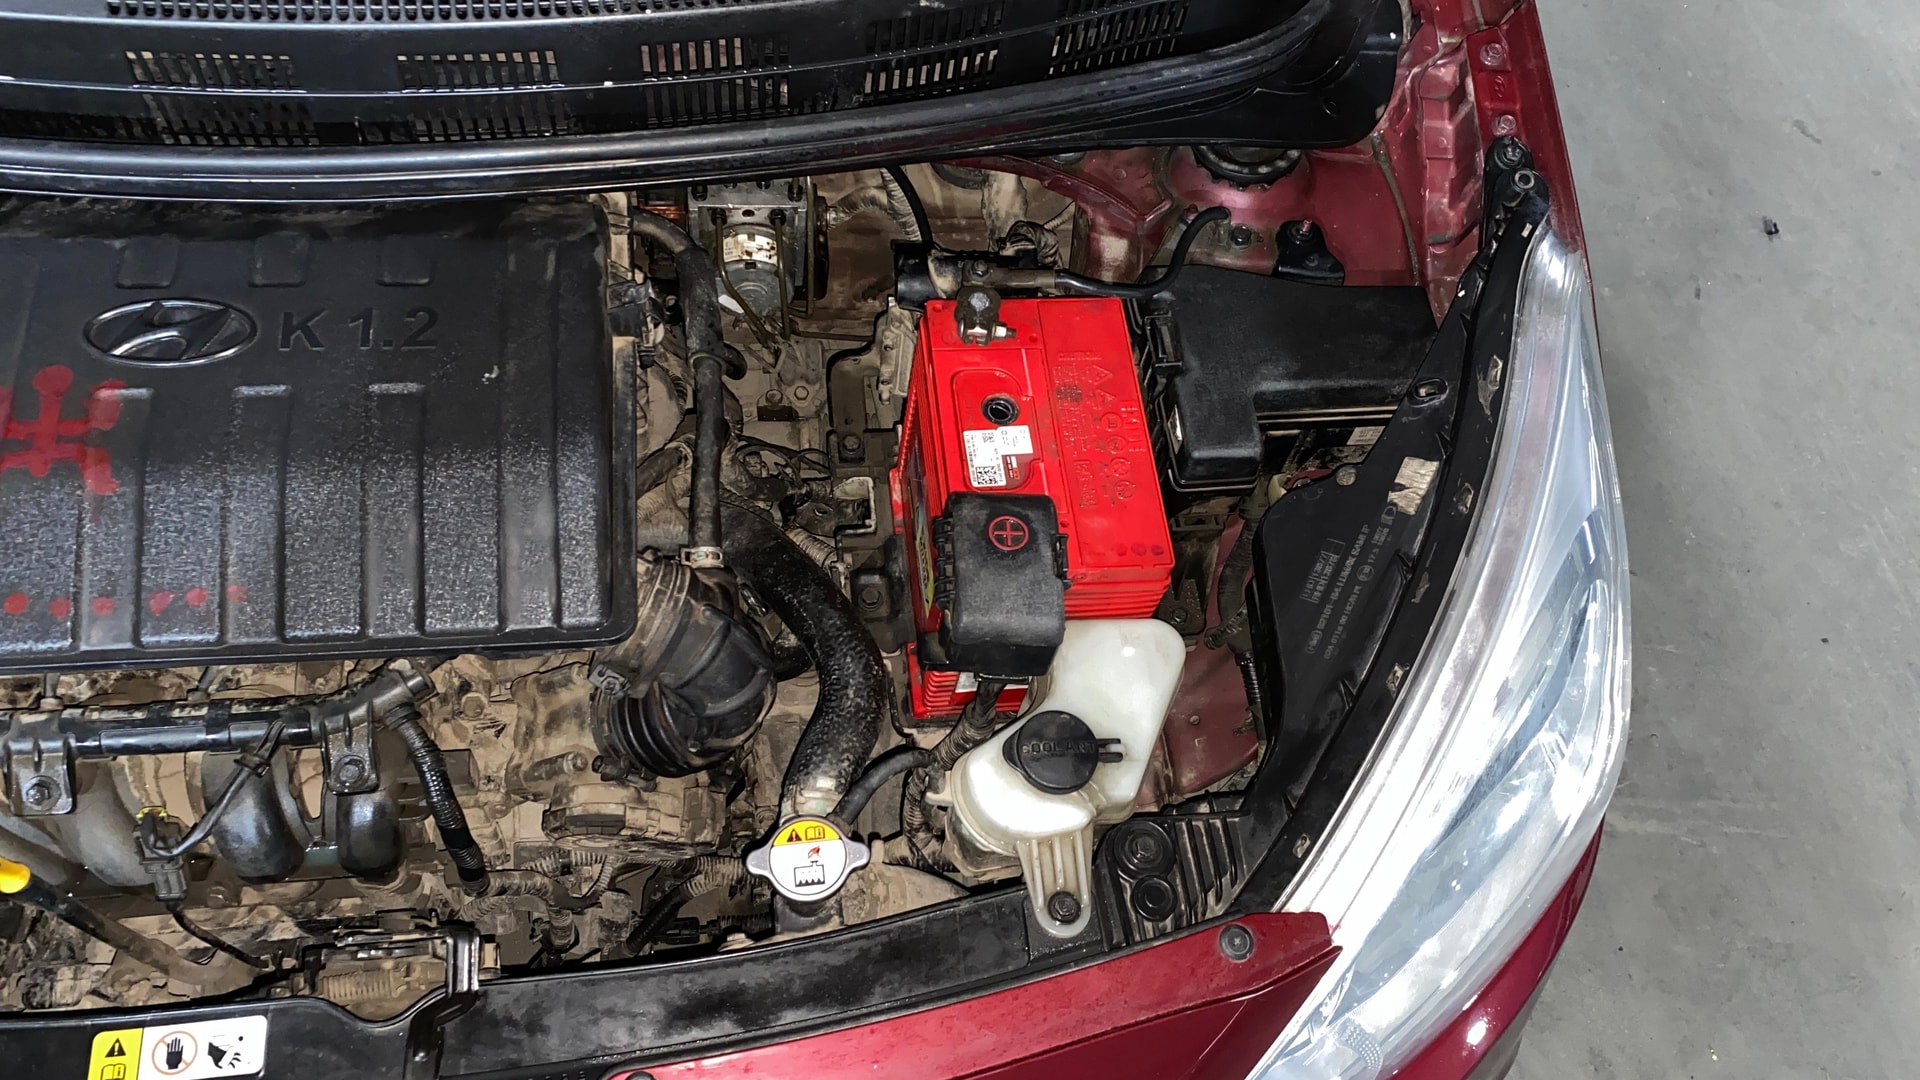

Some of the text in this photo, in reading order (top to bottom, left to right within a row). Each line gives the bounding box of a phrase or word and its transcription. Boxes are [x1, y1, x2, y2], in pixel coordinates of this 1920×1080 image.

[278, 305, 438, 351] K 1.2
[1021, 739, 1095, 754] COOLANT
